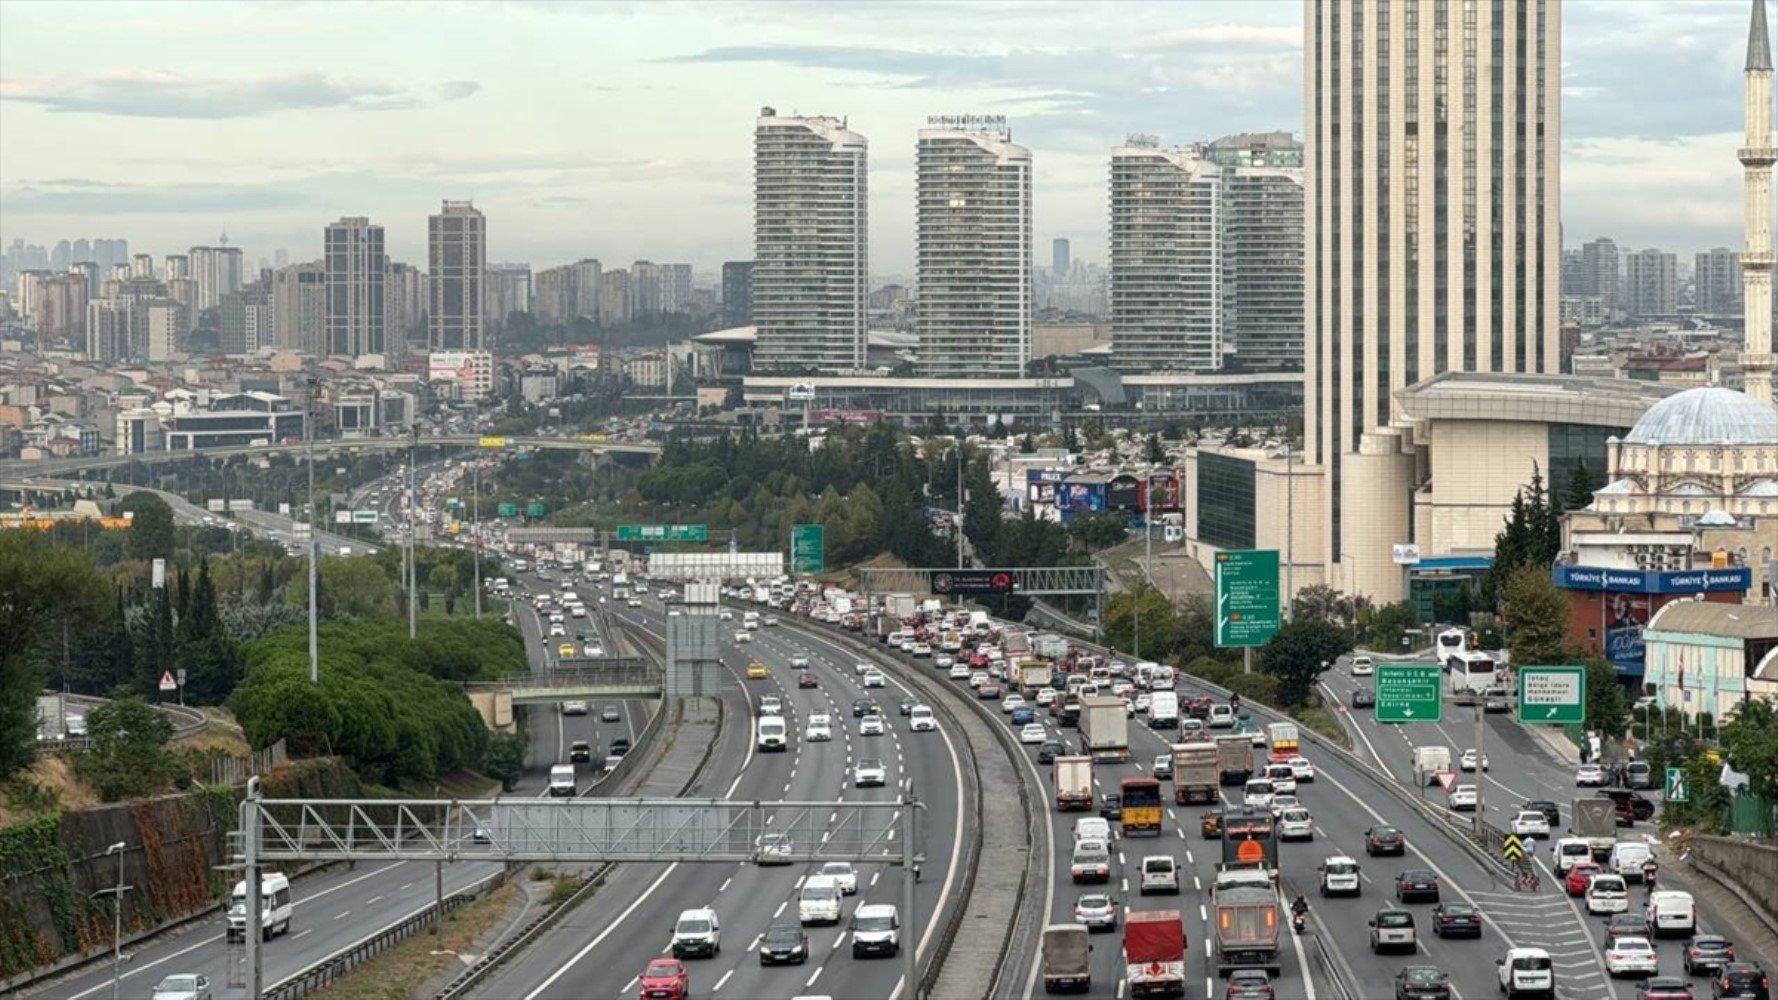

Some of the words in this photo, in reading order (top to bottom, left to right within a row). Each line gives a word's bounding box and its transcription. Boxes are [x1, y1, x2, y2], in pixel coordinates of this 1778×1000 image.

[1570, 572, 1600, 583] TÜRKİYE
[1608, 575, 1641, 585] BANKASI
[1670, 575, 1701, 586] TÜRKİYE
[1710, 575, 1741, 584] BANKASI
